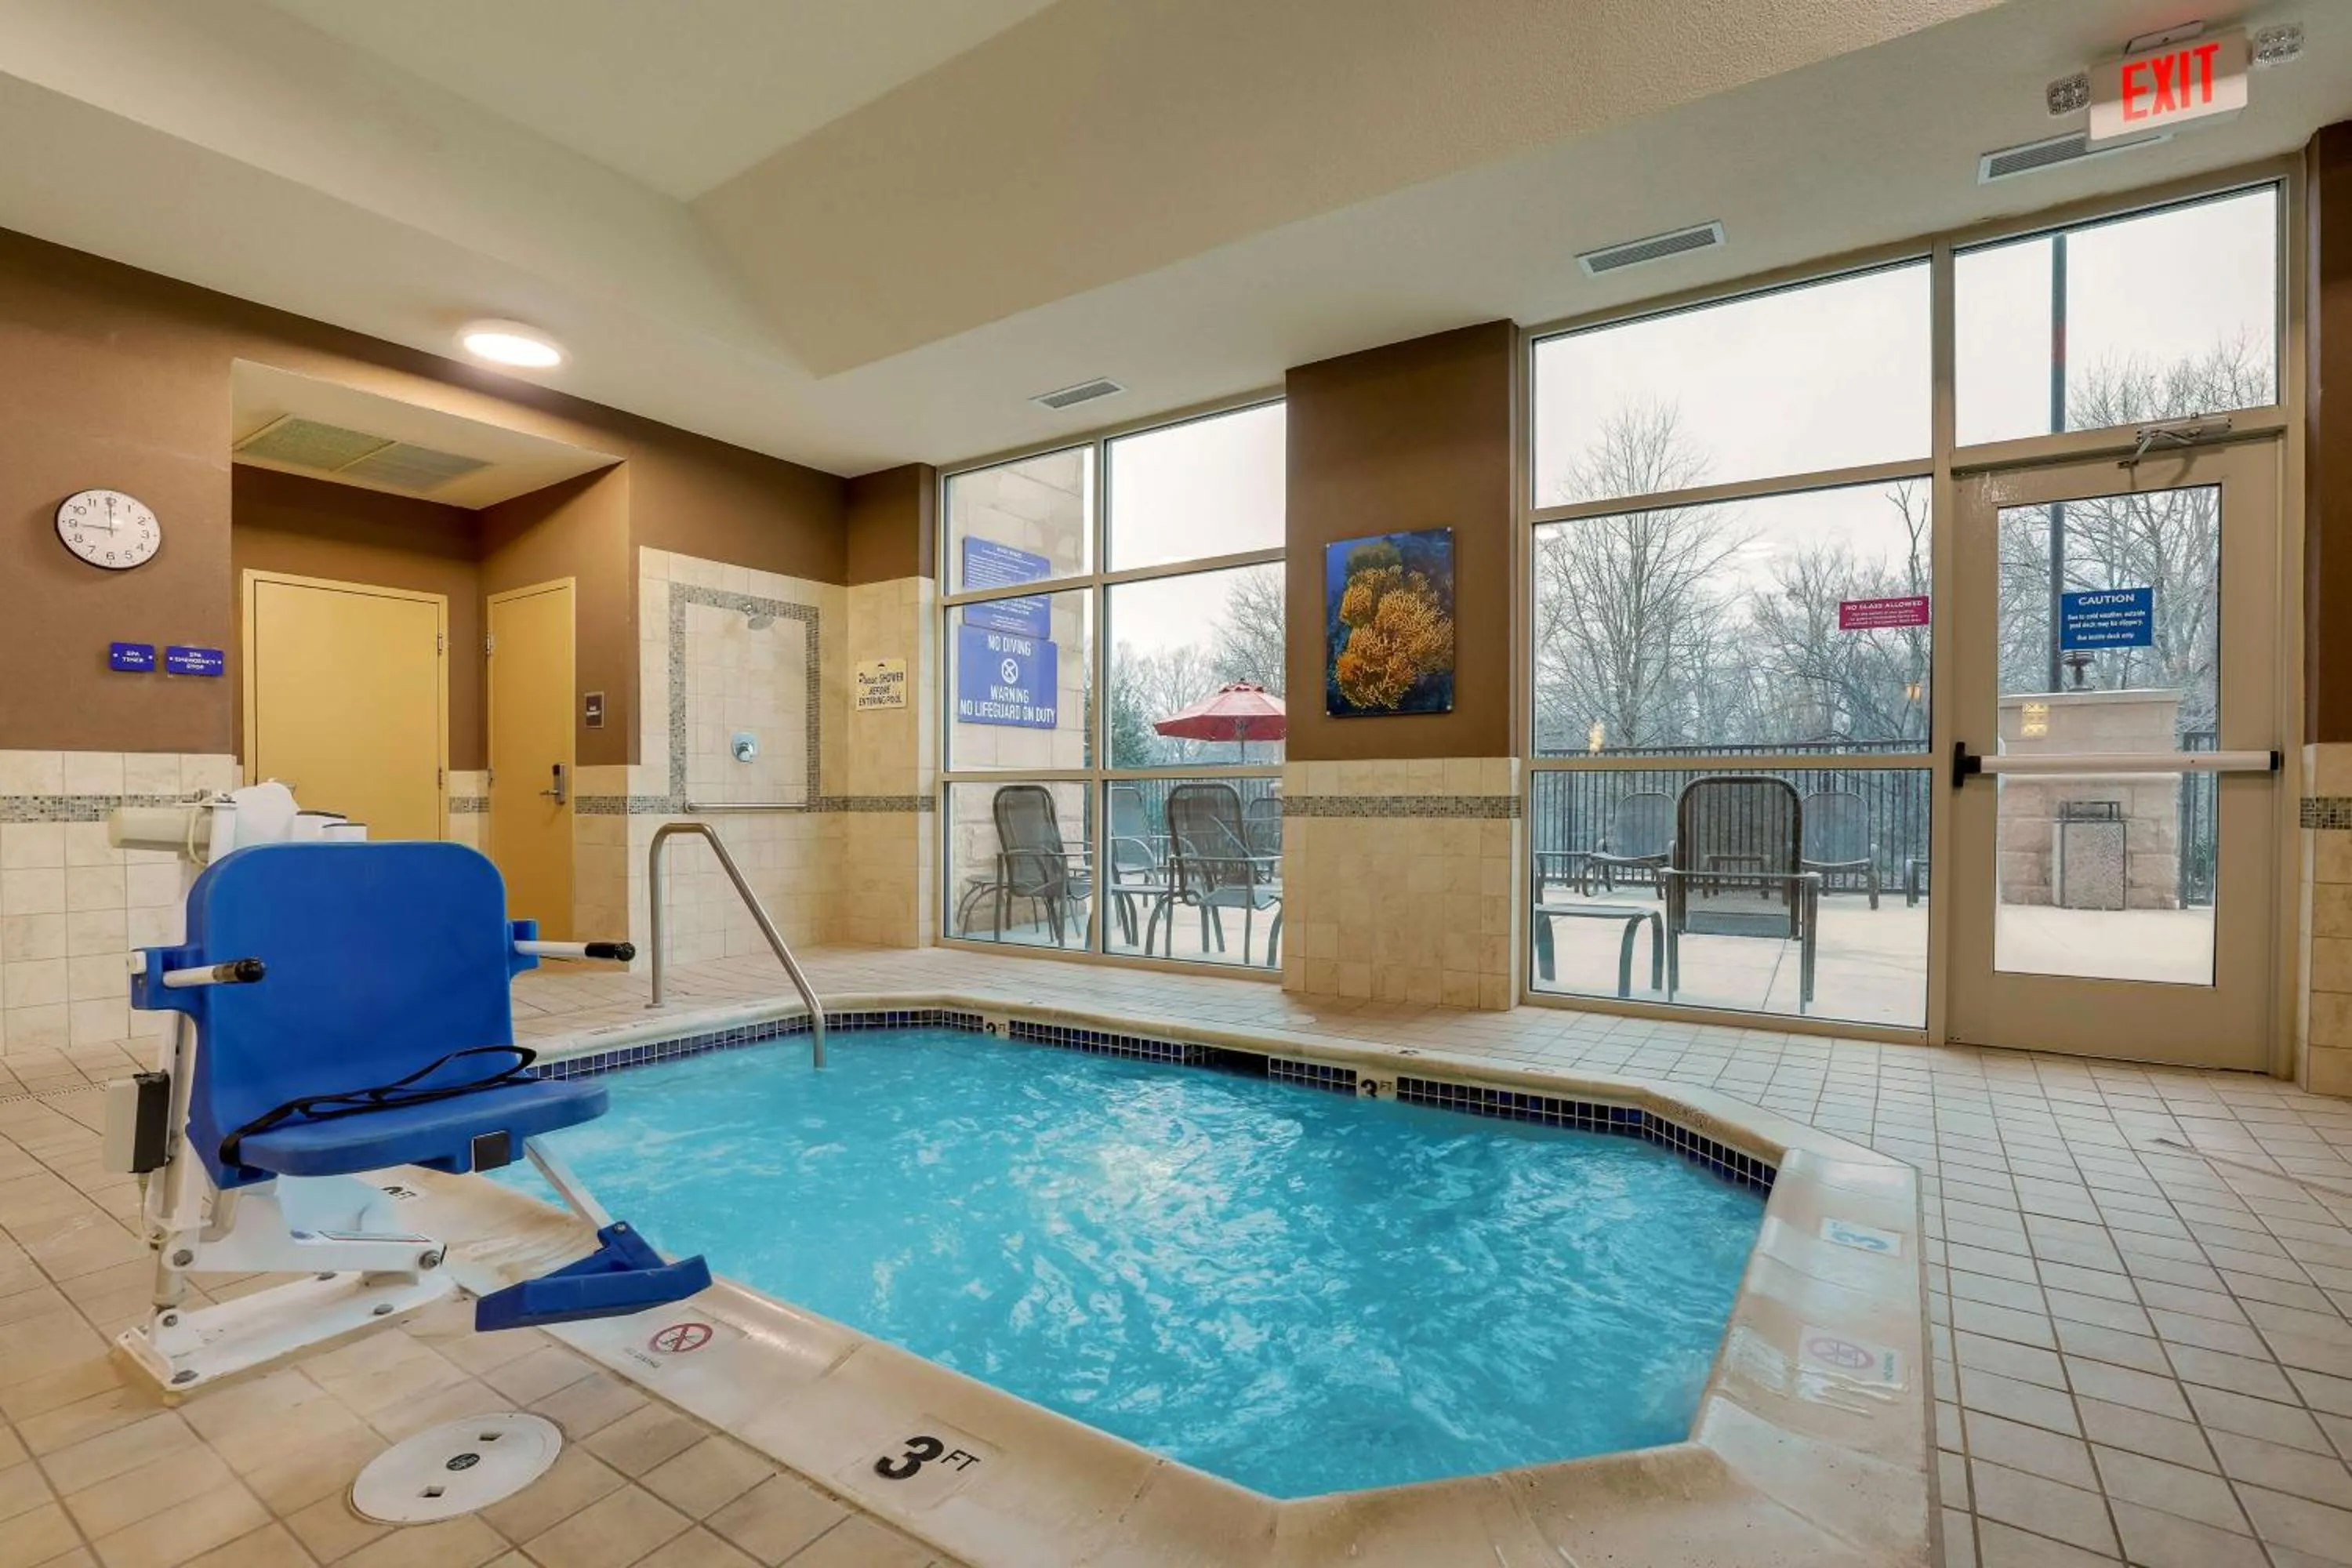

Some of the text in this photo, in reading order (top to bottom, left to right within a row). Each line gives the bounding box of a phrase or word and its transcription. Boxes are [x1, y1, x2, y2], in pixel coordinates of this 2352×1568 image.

[2121, 42, 2220, 123] EXIT
[88, 499, 96, 507] 11
[73, 506, 86, 515] 10
[68, 518, 77, 527] 9
[88, 545, 96, 554] 7
[125, 550, 132, 559] 5
[2078, 594, 2135, 605] CAUTION
[988, 634, 1031, 656] NO DIVING
[879, 671, 904, 683] SHOWER
[990, 684, 1029, 703] WARNING
[858, 696, 886, 706] ENTERING
[960, 699, 1054, 724] NO LIFEGUARD ON DUTY
[873, 1436, 982, 1480] 3 FT
